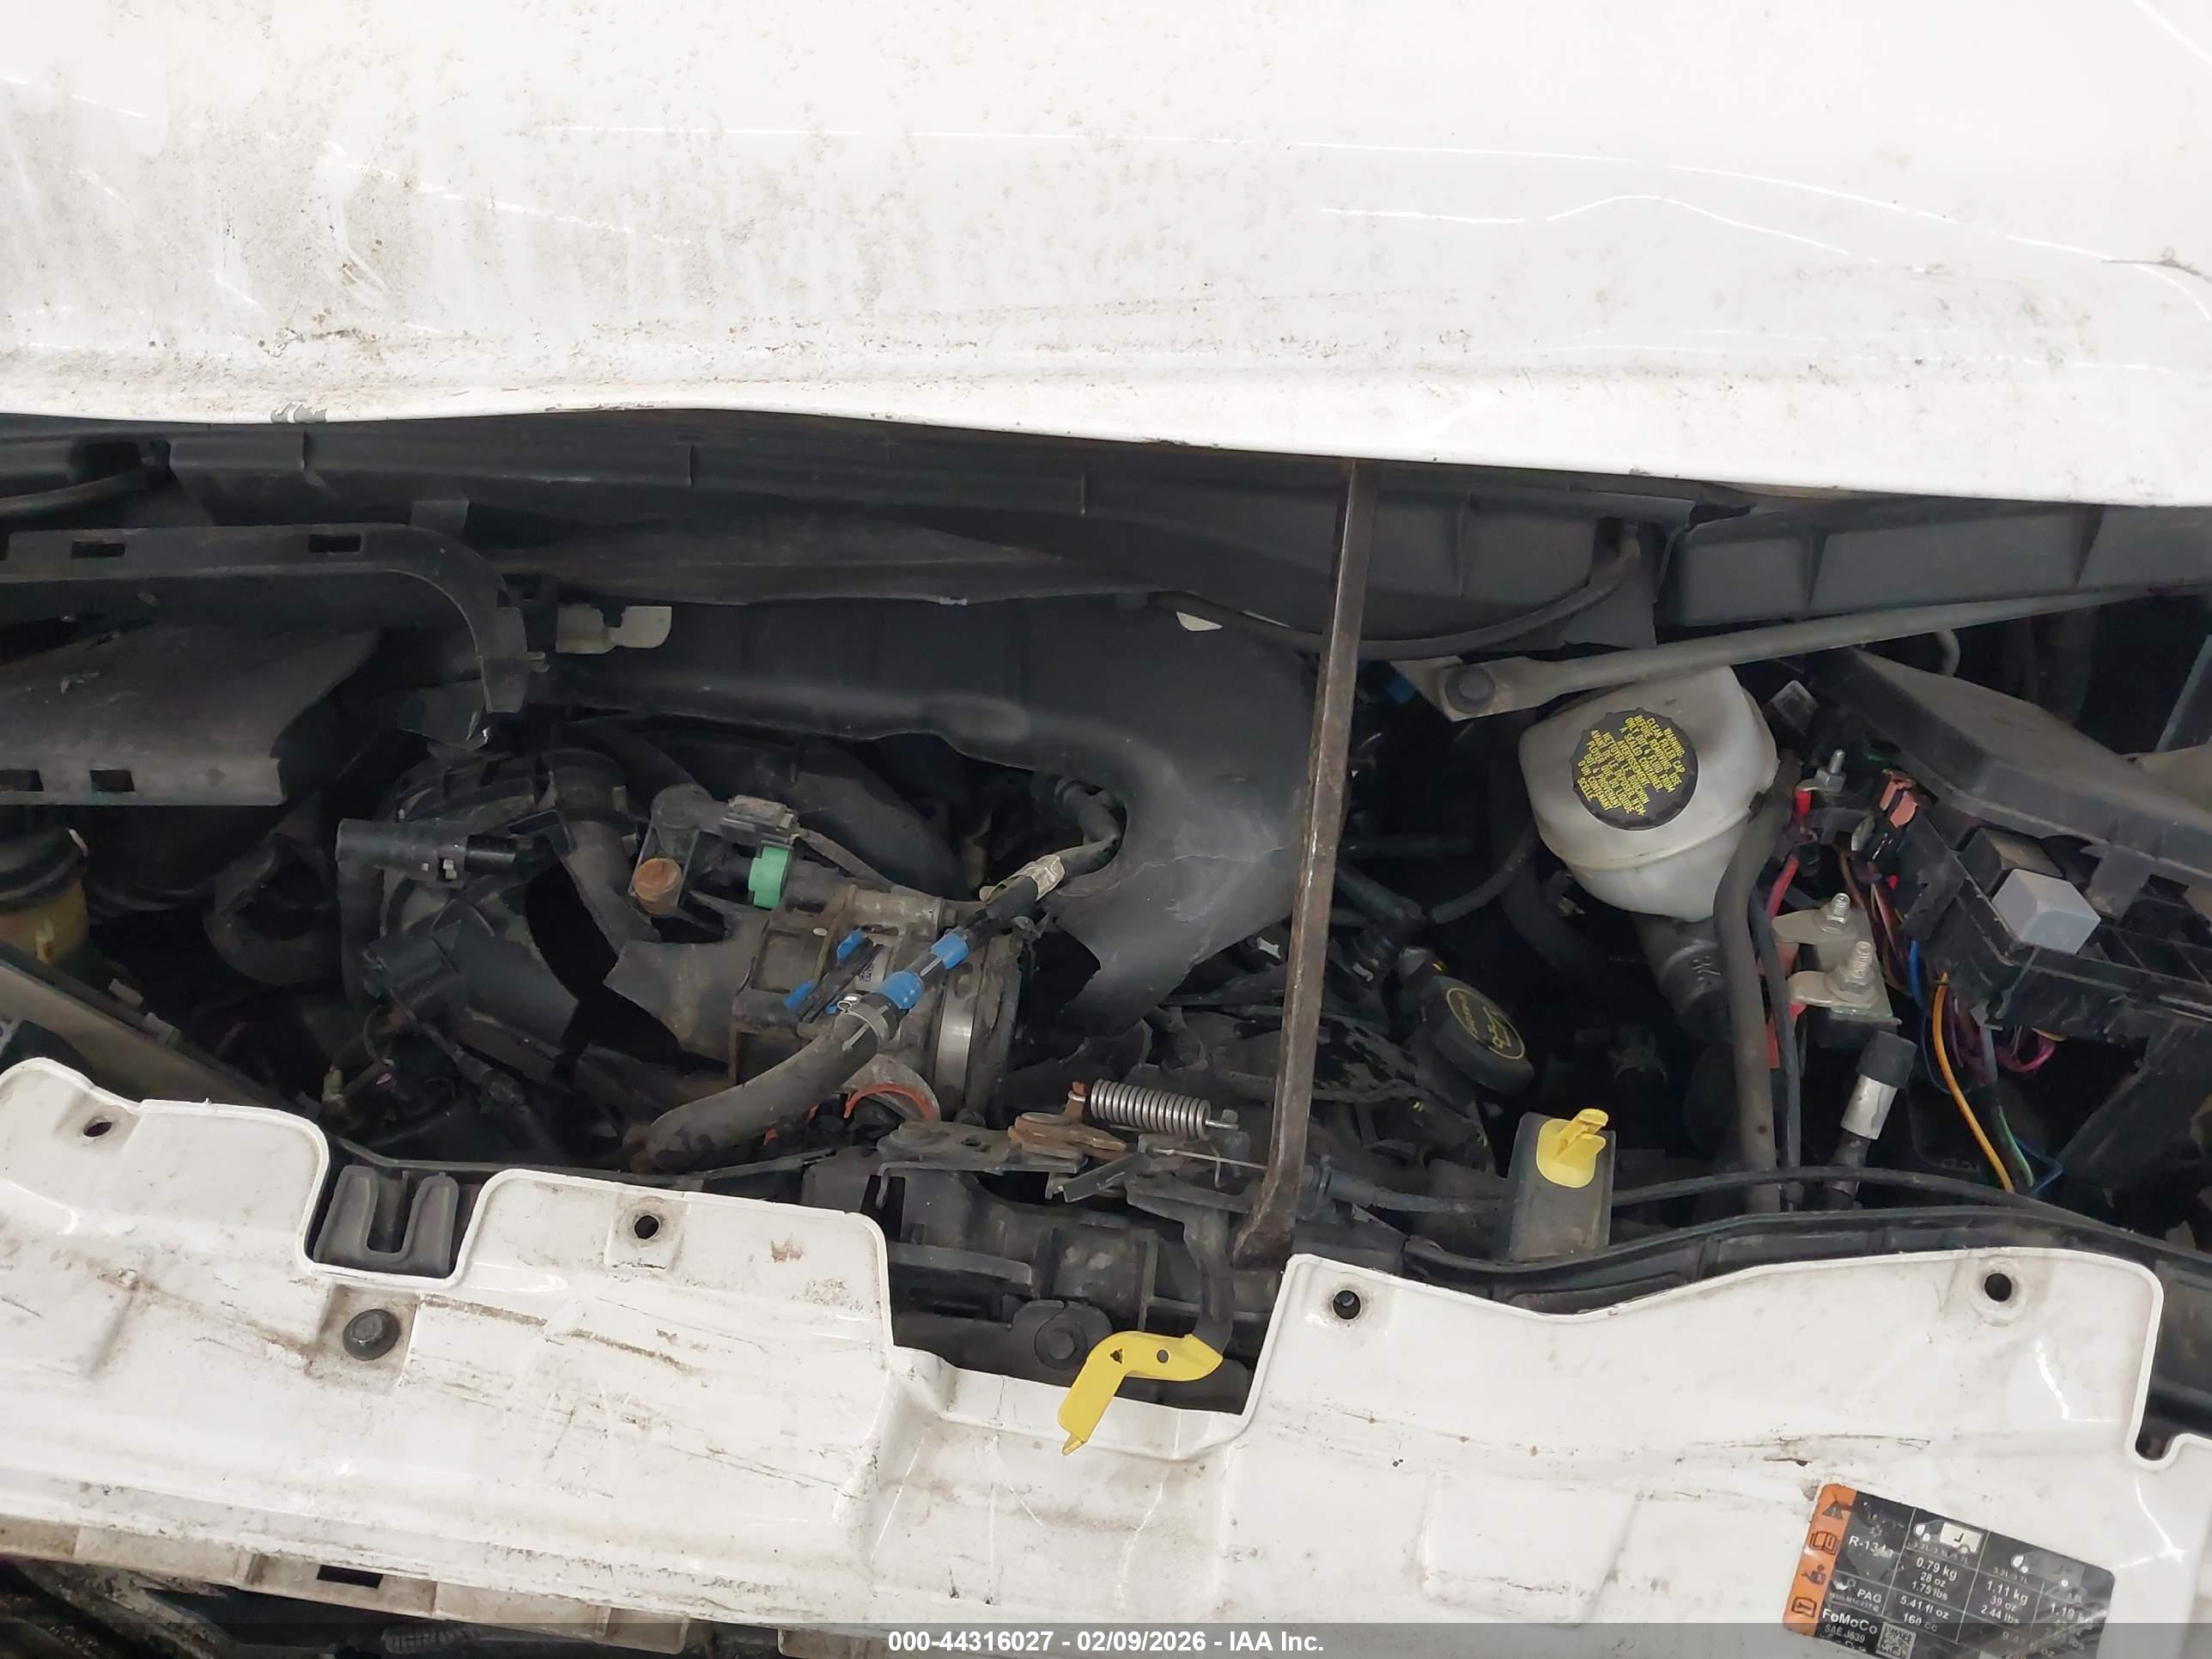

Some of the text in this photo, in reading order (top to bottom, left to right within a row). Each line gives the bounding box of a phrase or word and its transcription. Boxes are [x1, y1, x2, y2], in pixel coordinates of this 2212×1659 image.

[1591, 730, 1607, 749] AVANT
[1602, 750, 1613, 760] DE
[1608, 760, 1619, 769] LE
[1625, 733, 1643, 756] SEALED
[1626, 717, 1639, 736] ONLY
[1635, 734, 1648, 747] DOT
[1647, 755, 1663, 773] FLUID
[1659, 774, 1675, 793] FROM
[1634, 715, 1682, 787] BEFORE REMOVING. USE
[1647, 718, 1685, 773] CLEAN FILLER CAP
[1587, 741, 1635, 814] PLOYER QUE DU LIQUIDE
[1601, 732, 1650, 804] NETTOYER LE BOUCHON
[1584, 754, 1595, 766] DOT
[1595, 774, 1621, 810] PROVENANT
[1588, 776, 1613, 810] CONTENANT
[1914, 1556, 1959, 1582] 0.79 kg
[1919, 1571, 1947, 1588] 28 oz
[1856, 1587, 1883, 1605] PAG
[1929, 1587, 1949, 1601] lbs
[1984, 1579, 2030, 1607] 1.11 kg
[1989, 1595, 2018, 1612] 39 oz
[1820, 1607, 1880, 1635] FoMoCo
[1899, 1595, 1951, 1620] 5.41 fl oz
[1979, 1604, 2021, 1626] 2.44 lbs
[1824, 1623, 1843, 1637] SAE
[1901, 1613, 1938, 1632] 160 cc
